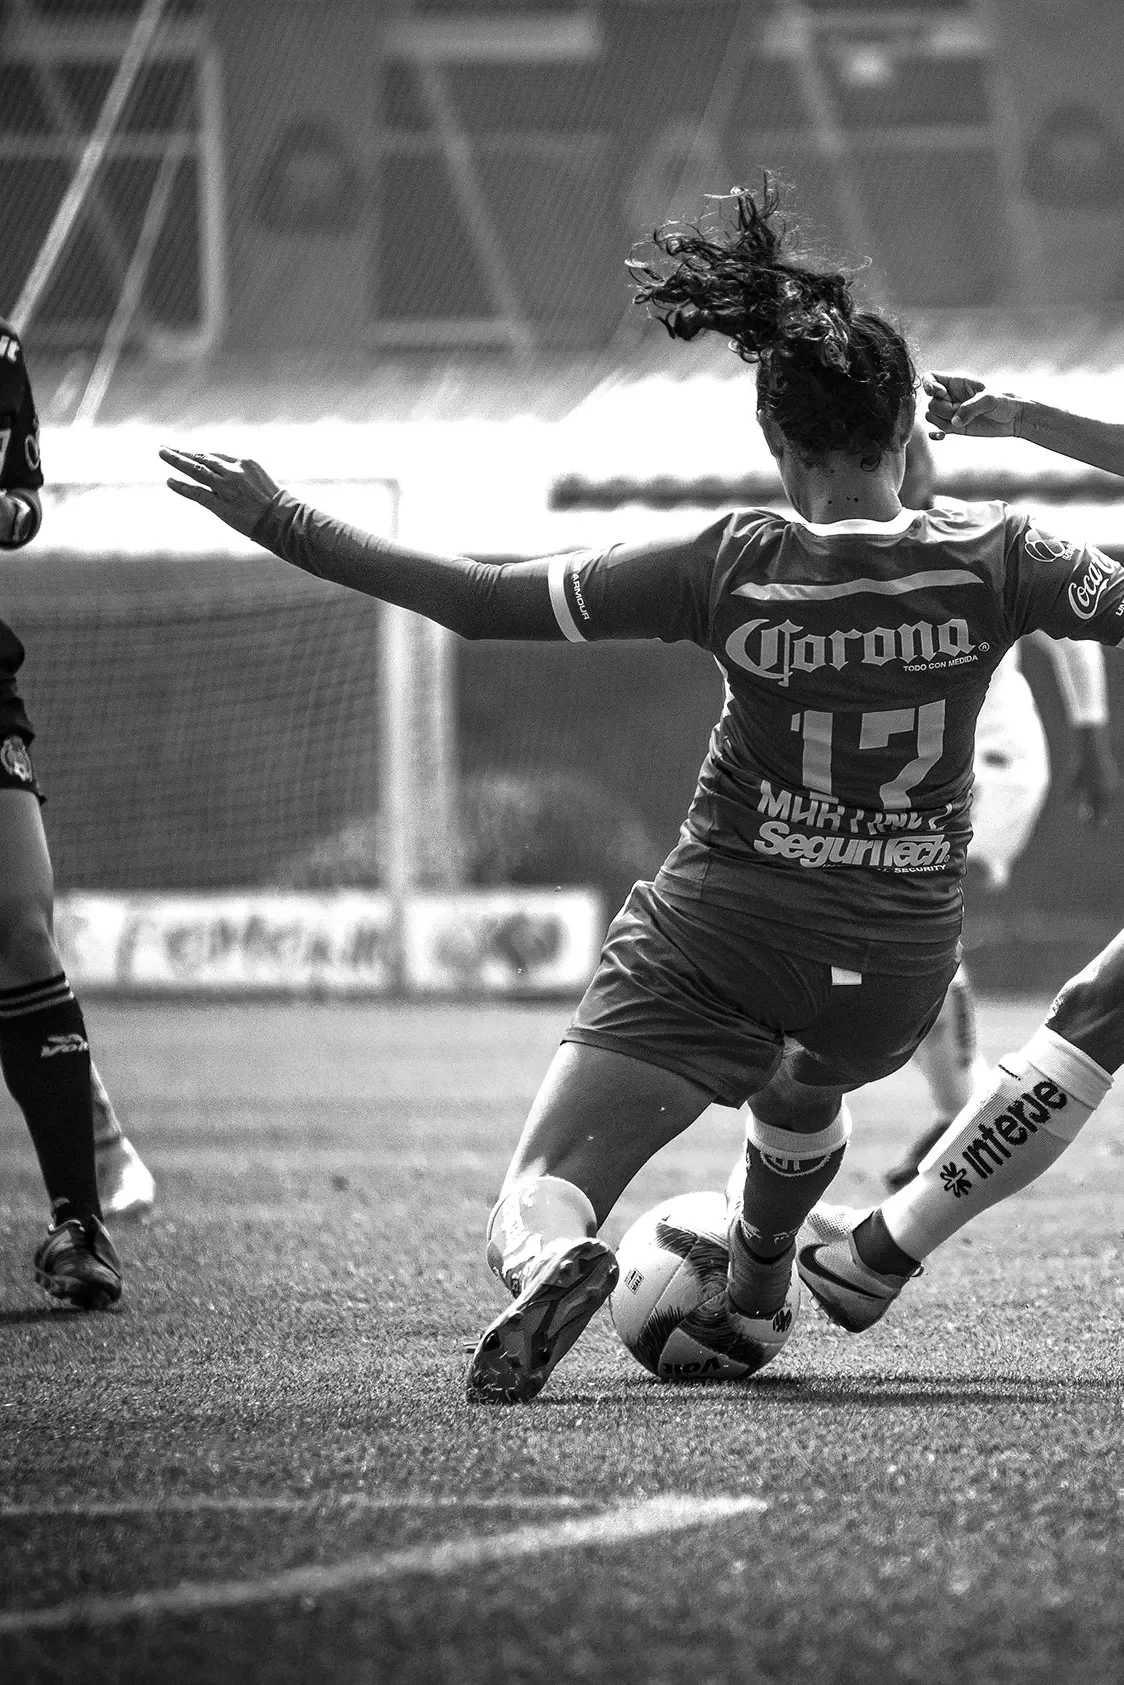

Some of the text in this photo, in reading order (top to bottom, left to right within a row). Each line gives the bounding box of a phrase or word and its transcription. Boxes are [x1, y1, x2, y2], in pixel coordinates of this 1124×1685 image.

[571, 572, 590, 620] ARMOUR
[725, 617, 976, 686] Corona
[903, 655, 979, 672] TODO CON MEDIDA
[790, 699, 946, 810] 17
[895, 864, 947, 874] SECURITY
[962, 1081, 1068, 1179] interje
